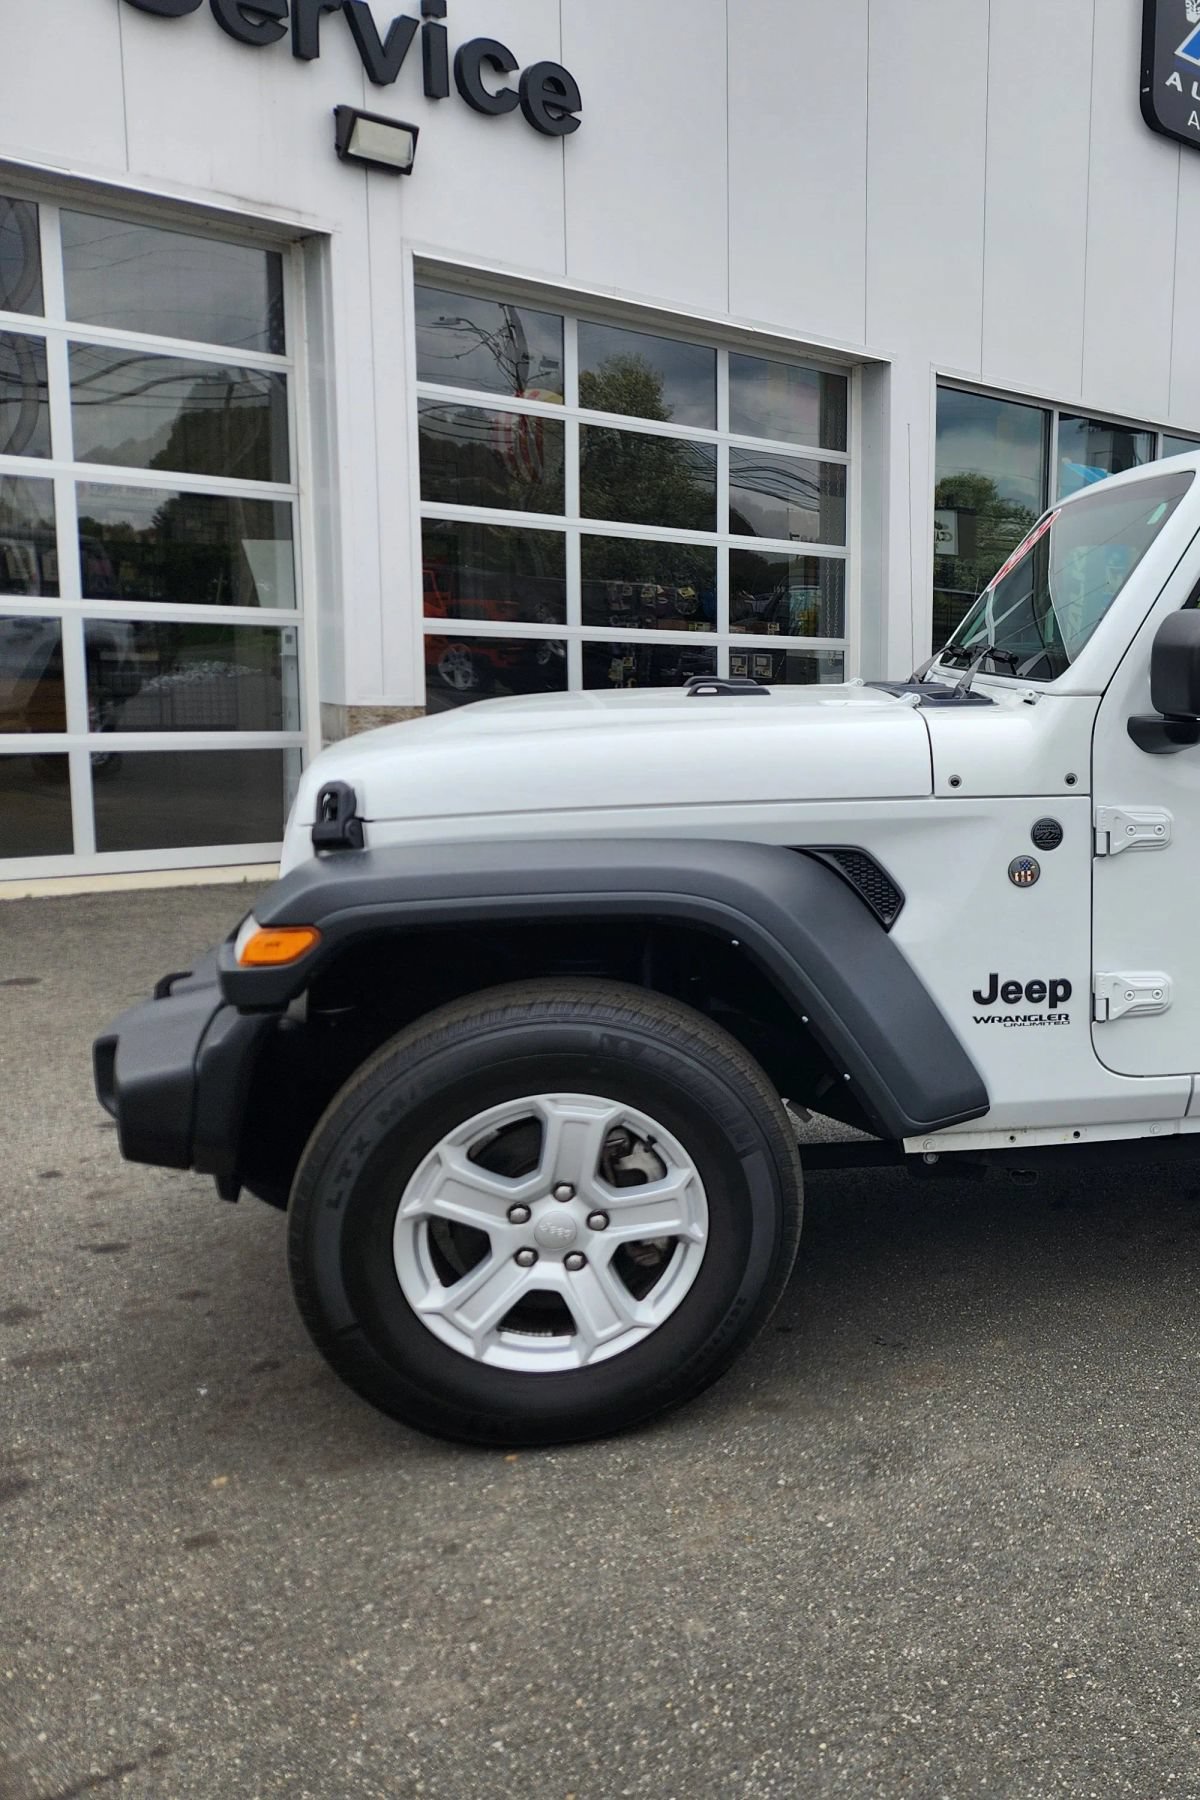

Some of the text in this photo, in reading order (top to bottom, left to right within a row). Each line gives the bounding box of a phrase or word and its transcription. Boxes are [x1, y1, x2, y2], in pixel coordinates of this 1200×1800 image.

[121, 0, 582, 137] ervice
[972, 972, 1072, 1009] Jeep
[972, 1013, 1070, 1024] WRANGLER
[1003, 1020, 1070, 1028] UNLIMITED
